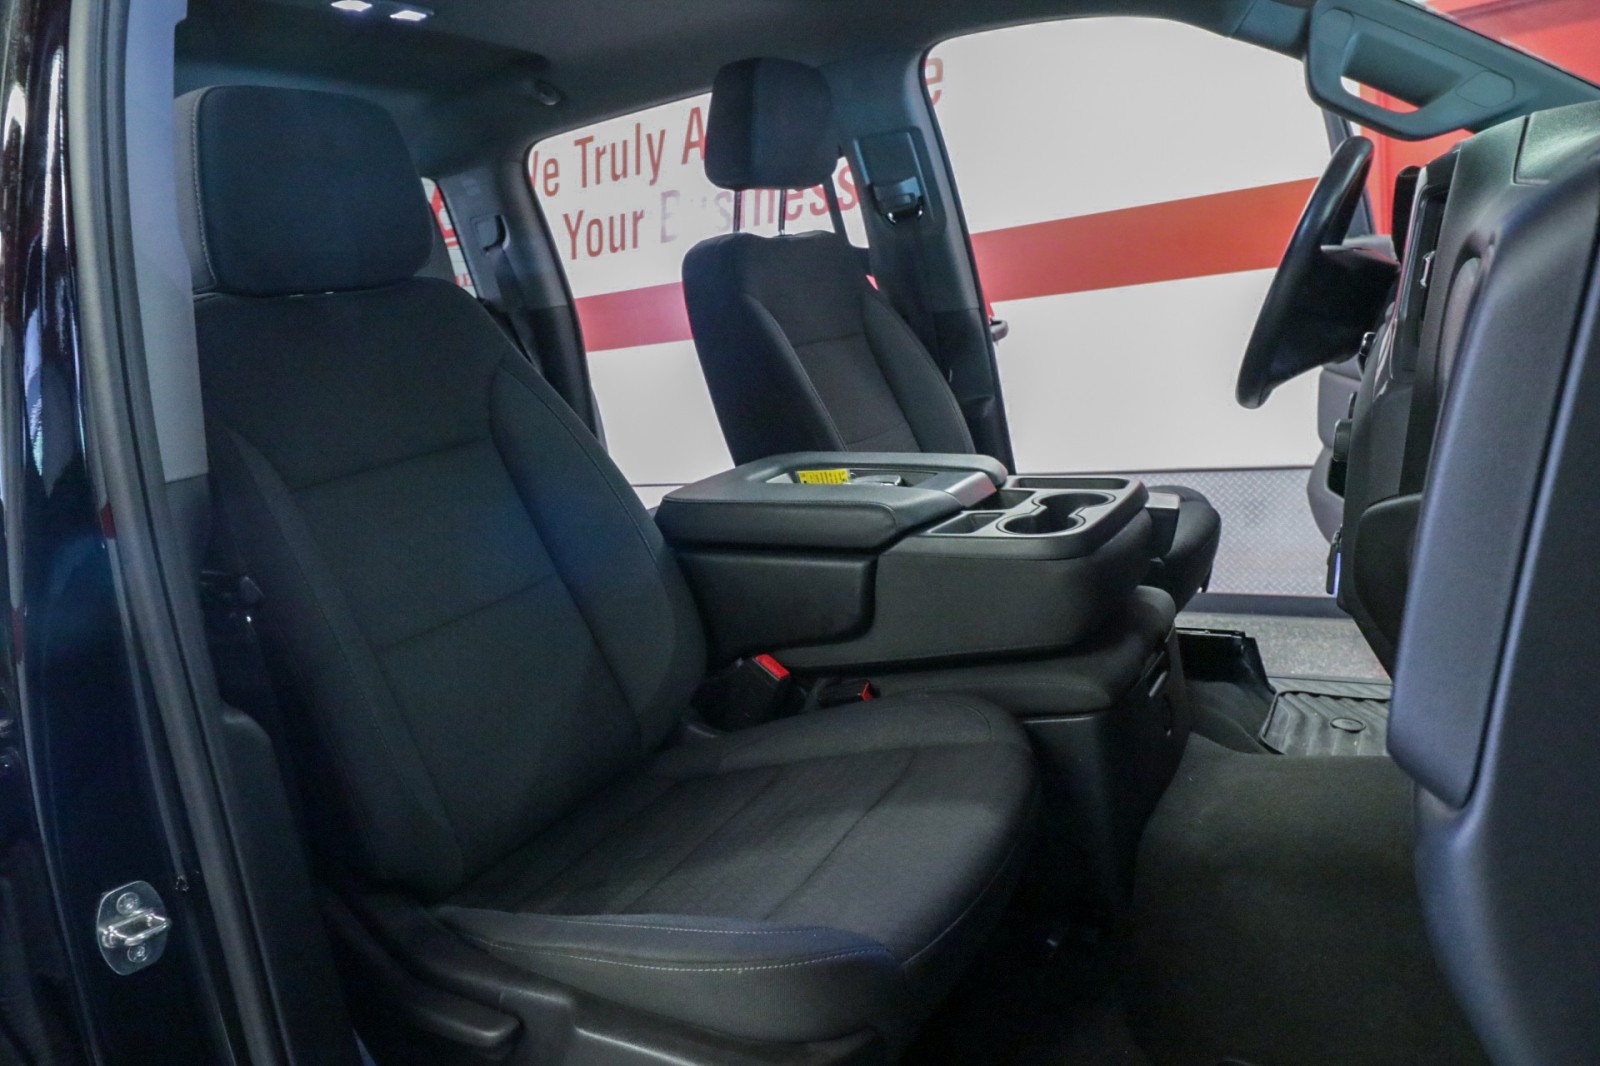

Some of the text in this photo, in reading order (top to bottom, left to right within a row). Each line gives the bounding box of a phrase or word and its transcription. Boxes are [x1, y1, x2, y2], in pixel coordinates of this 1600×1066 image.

[573, 122, 666, 188] Truly
[562, 165, 861, 260] Your Bsiness
